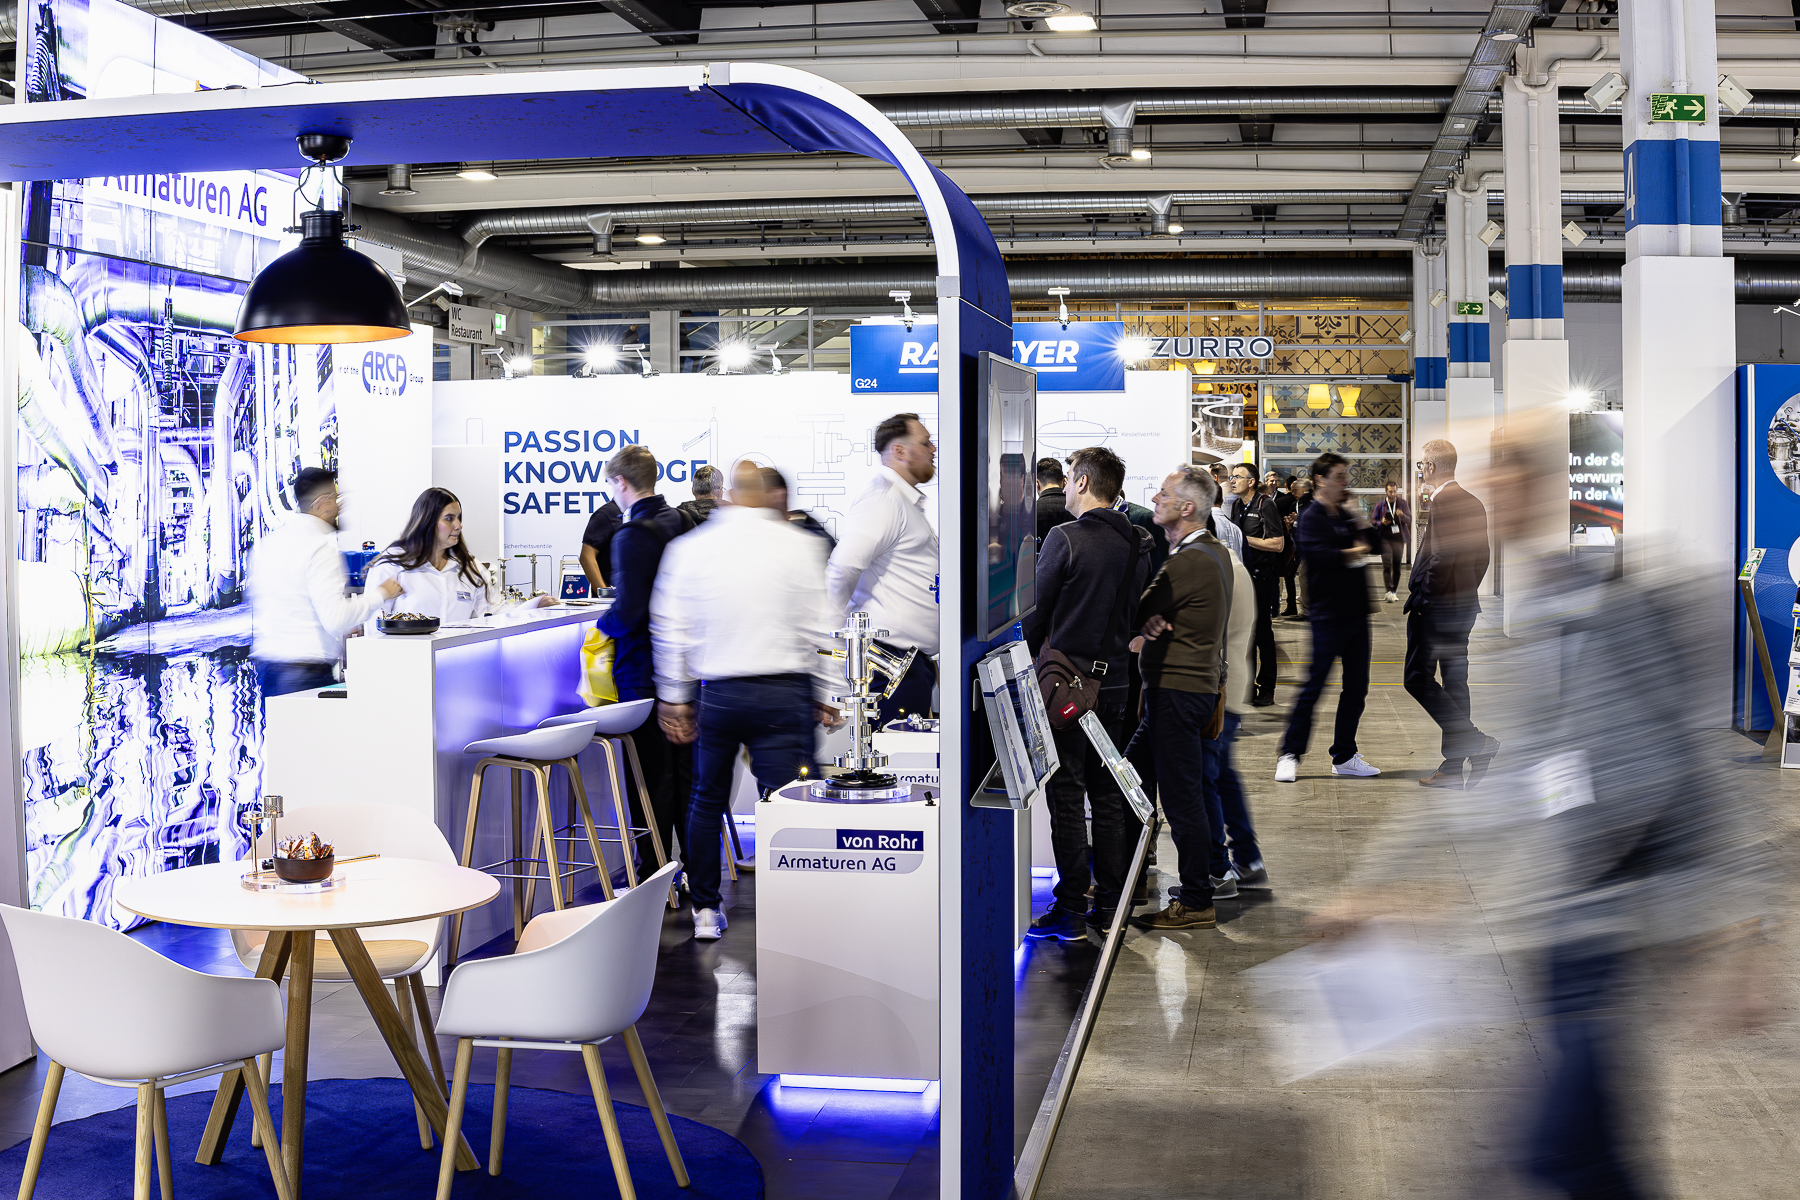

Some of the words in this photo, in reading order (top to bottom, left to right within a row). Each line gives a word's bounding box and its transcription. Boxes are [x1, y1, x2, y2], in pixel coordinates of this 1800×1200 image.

[1626, 151, 1636, 222] 4
[237, 182, 268, 227] AG
[451, 306, 462, 321] WC
[451, 323, 483, 341] Restaurant
[1144, 336, 1273, 358] ZURRO
[350, 367, 359, 376] the
[362, 350, 407, 396] ARCA
[409, 373, 424, 385] Group
[372, 385, 397, 397] FLOW
[855, 378, 878, 389] G24
[1569, 452, 1582, 466] In
[1585, 452, 1609, 467] der
[504, 460, 708, 484] KNOWGE
[1569, 472, 1624, 484] verwurz
[1569, 486, 1582, 500] In
[1585, 486, 1609, 501] der
[842, 835, 873, 849] von
[878, 833, 918, 850] Rohr
[777, 854, 867, 871] Armaturen
[871, 856, 896, 871] AG
